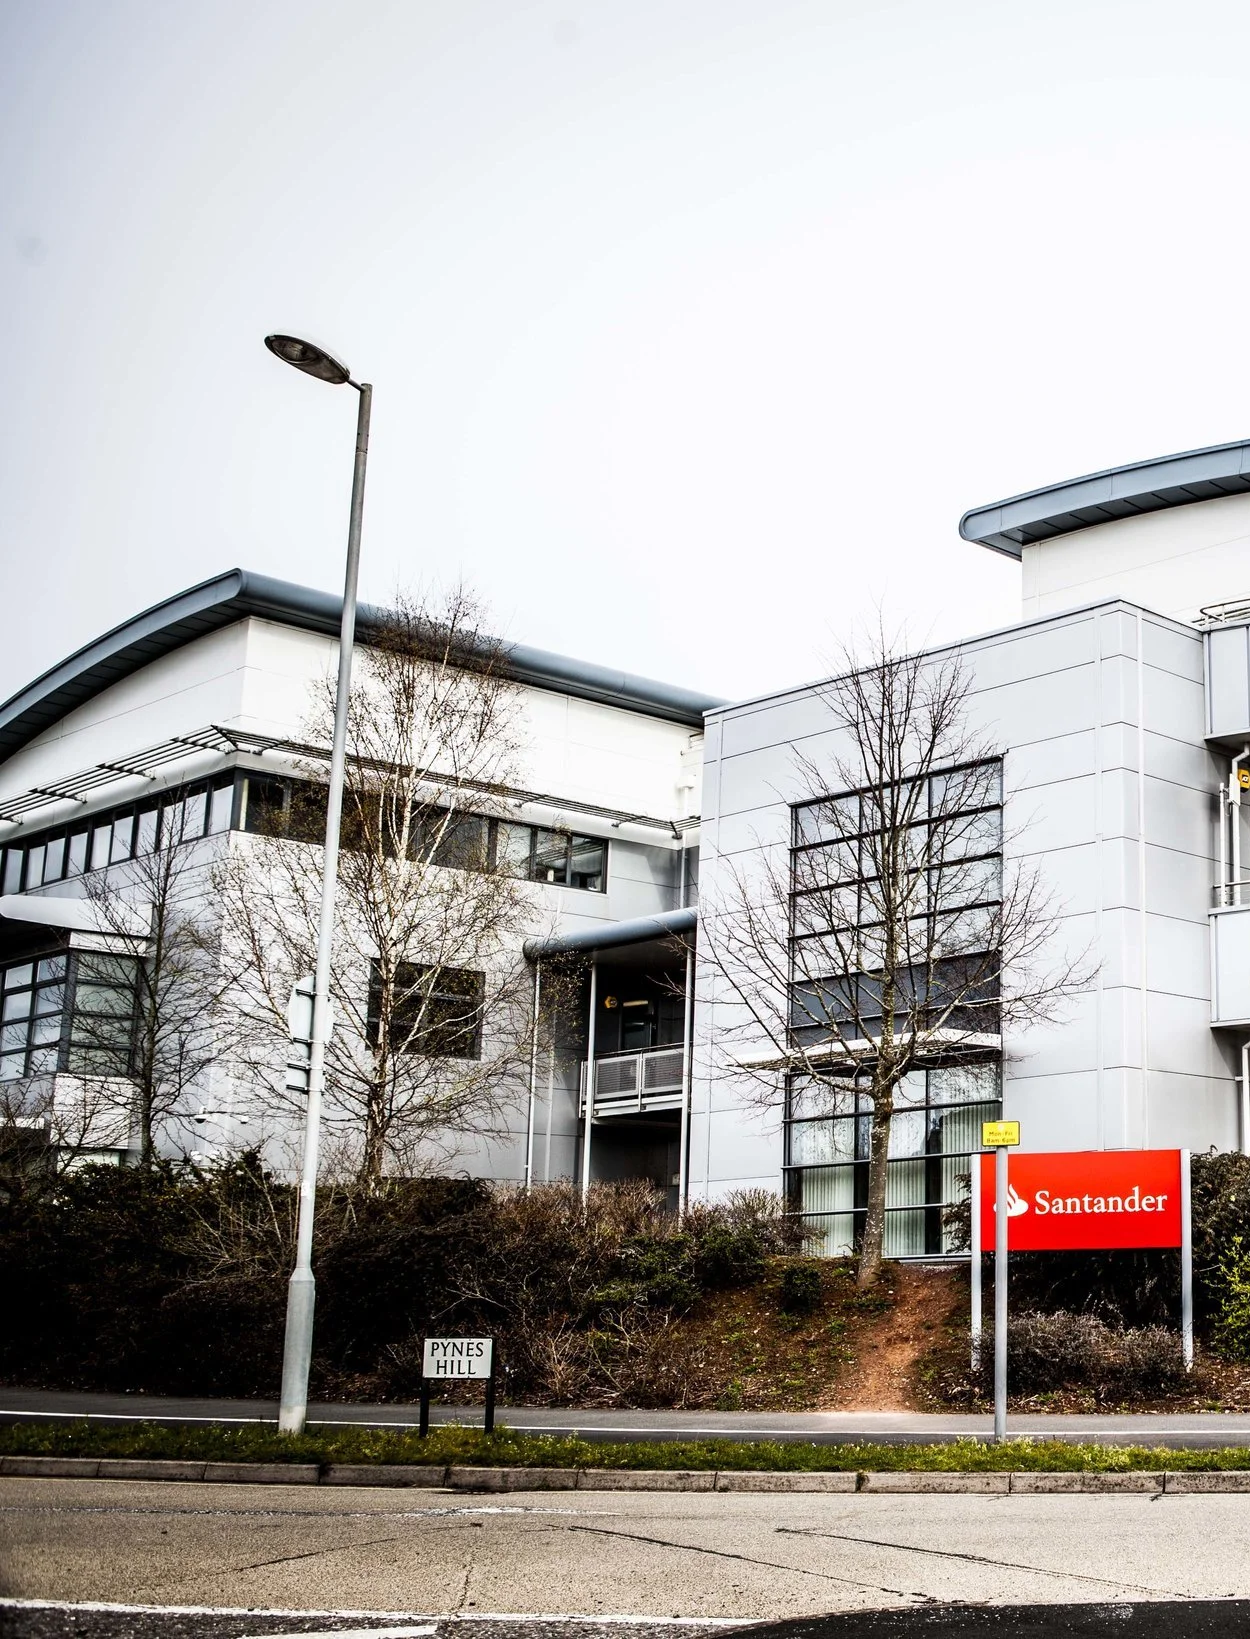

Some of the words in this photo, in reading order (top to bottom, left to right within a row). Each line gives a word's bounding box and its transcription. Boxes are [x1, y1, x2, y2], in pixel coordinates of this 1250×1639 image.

[1034, 1186, 1168, 1215] Santander
[430, 1342, 484, 1357] PYNES
[436, 1360, 476, 1375] HILL
